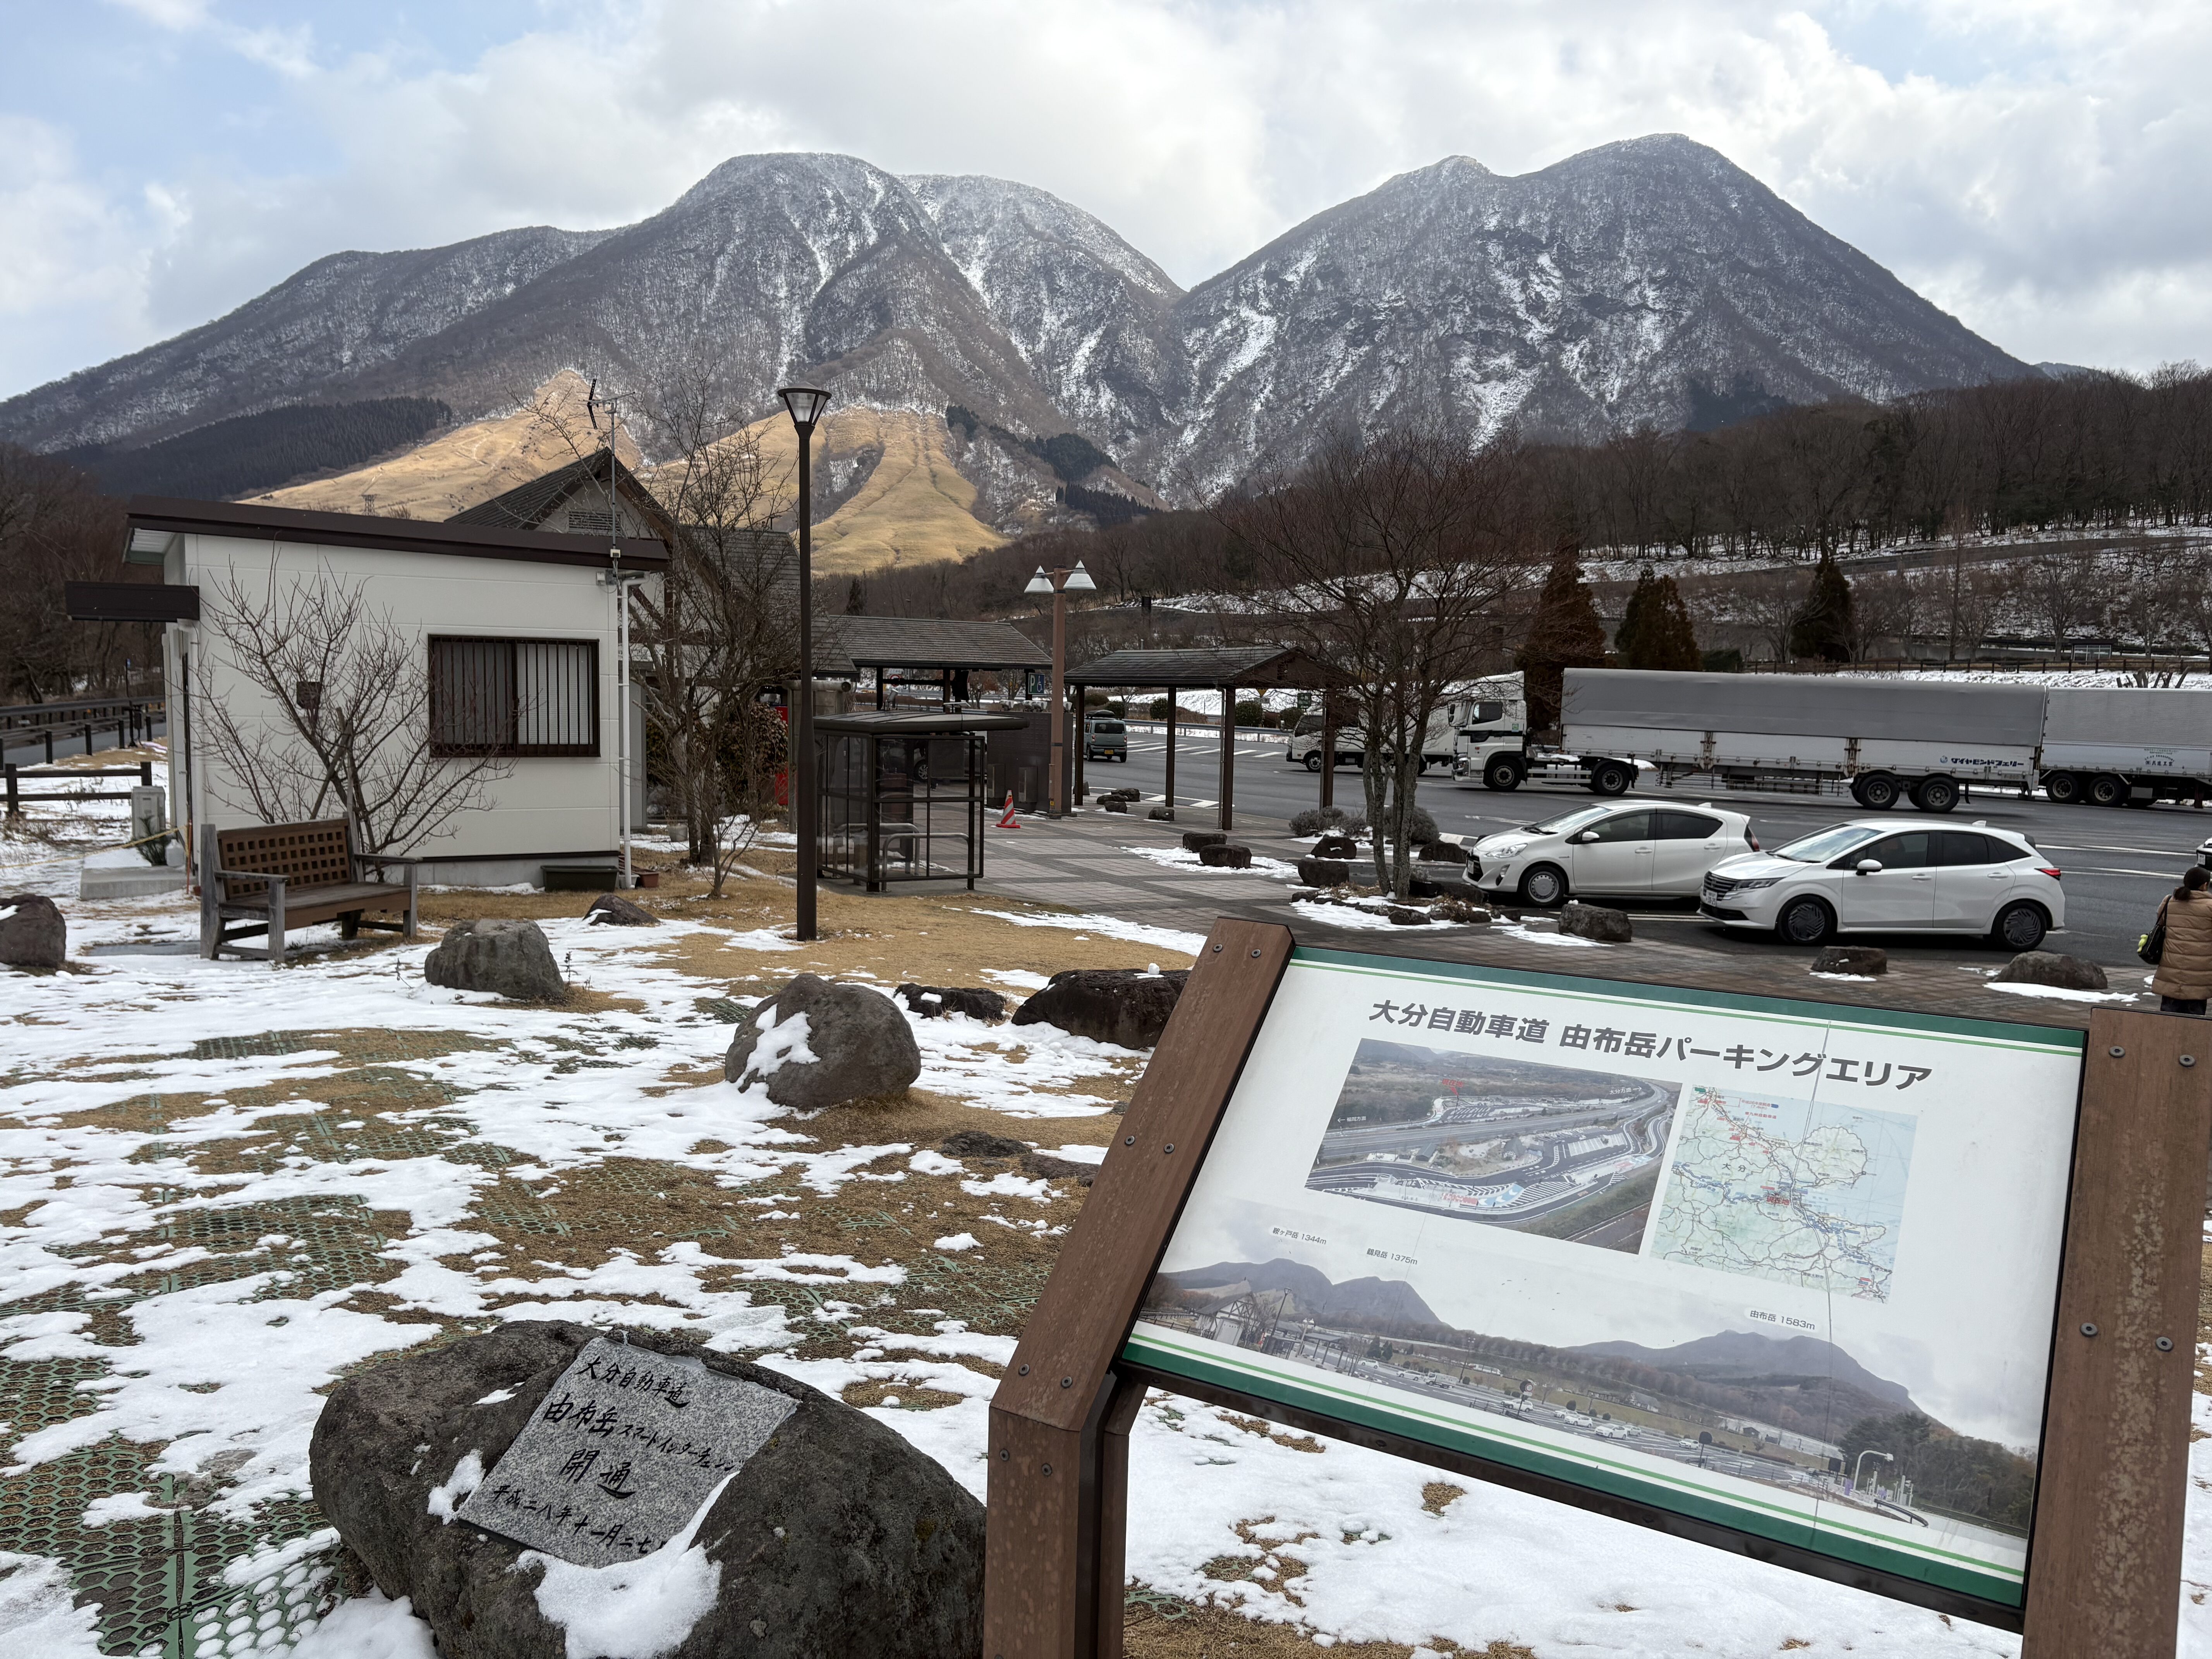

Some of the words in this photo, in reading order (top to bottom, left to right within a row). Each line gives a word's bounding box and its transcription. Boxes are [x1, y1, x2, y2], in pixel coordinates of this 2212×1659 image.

[1030, 675, 1035, 692] P
[1369, 999, 1549, 1043] 大分自動車道
[1559, 1025, 1934, 1091] 由布岳パーキングエリア
[1301, 1233, 1327, 1245] 1344m
[1366, 1248, 1388, 1259] 鶴見岳
[1391, 1253, 1418, 1265] 1375m
[1750, 1310, 1777, 1322] 由布岳
[1781, 1316, 1815, 1330] 1583m
[575, 1356, 689, 1408] 大分自動車道
[543, 1391, 744, 1472] 由布岳スマートインターチェンジ
[559, 1448, 636, 1499] 開通
